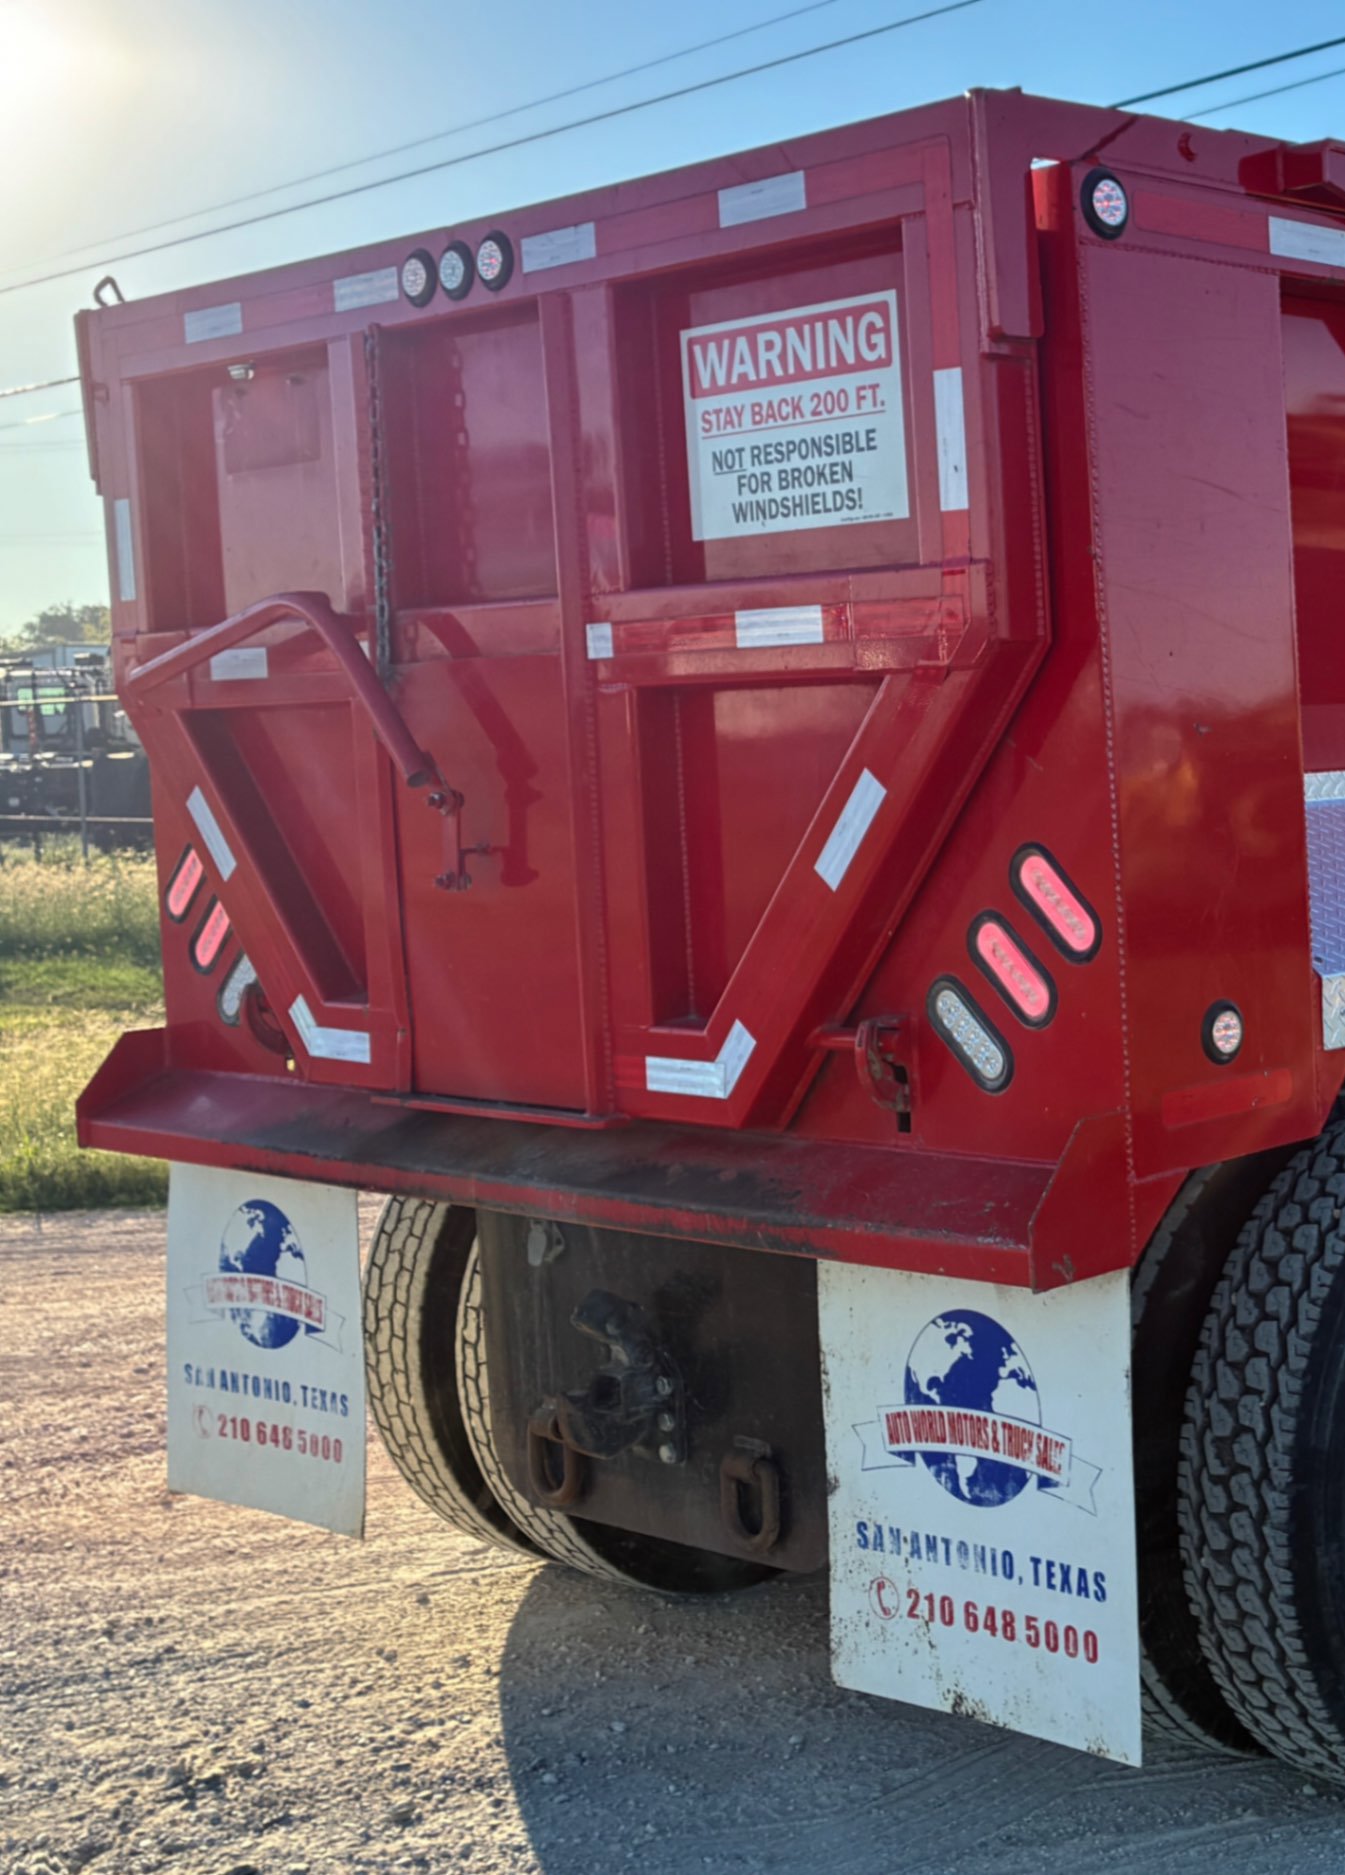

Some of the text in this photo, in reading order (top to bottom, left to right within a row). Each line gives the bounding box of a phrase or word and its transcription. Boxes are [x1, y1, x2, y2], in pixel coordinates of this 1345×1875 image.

[693, 311, 886, 390] WARNING
[701, 383, 886, 434] STAY BACK 200 FT.
[711, 428, 878, 473] NOT RESPONSIBLE
[737, 460, 854, 496] FOR BROKEN
[732, 487, 864, 524] WINDSHIELDS!
[300, 1385, 349, 1417] TEXAS
[217, 1413, 343, 1464] 210 648 5000
[885, 1411, 912, 1446] AUTO
[910, 1409, 947, 1444] WORLD
[947, 1411, 990, 1451] MOTORS
[991, 1419, 1001, 1453] &
[856, 1520, 1107, 1603] SAN ANTONIO, TEXAS
[906, 1588, 1099, 1664] 210 648 5000
